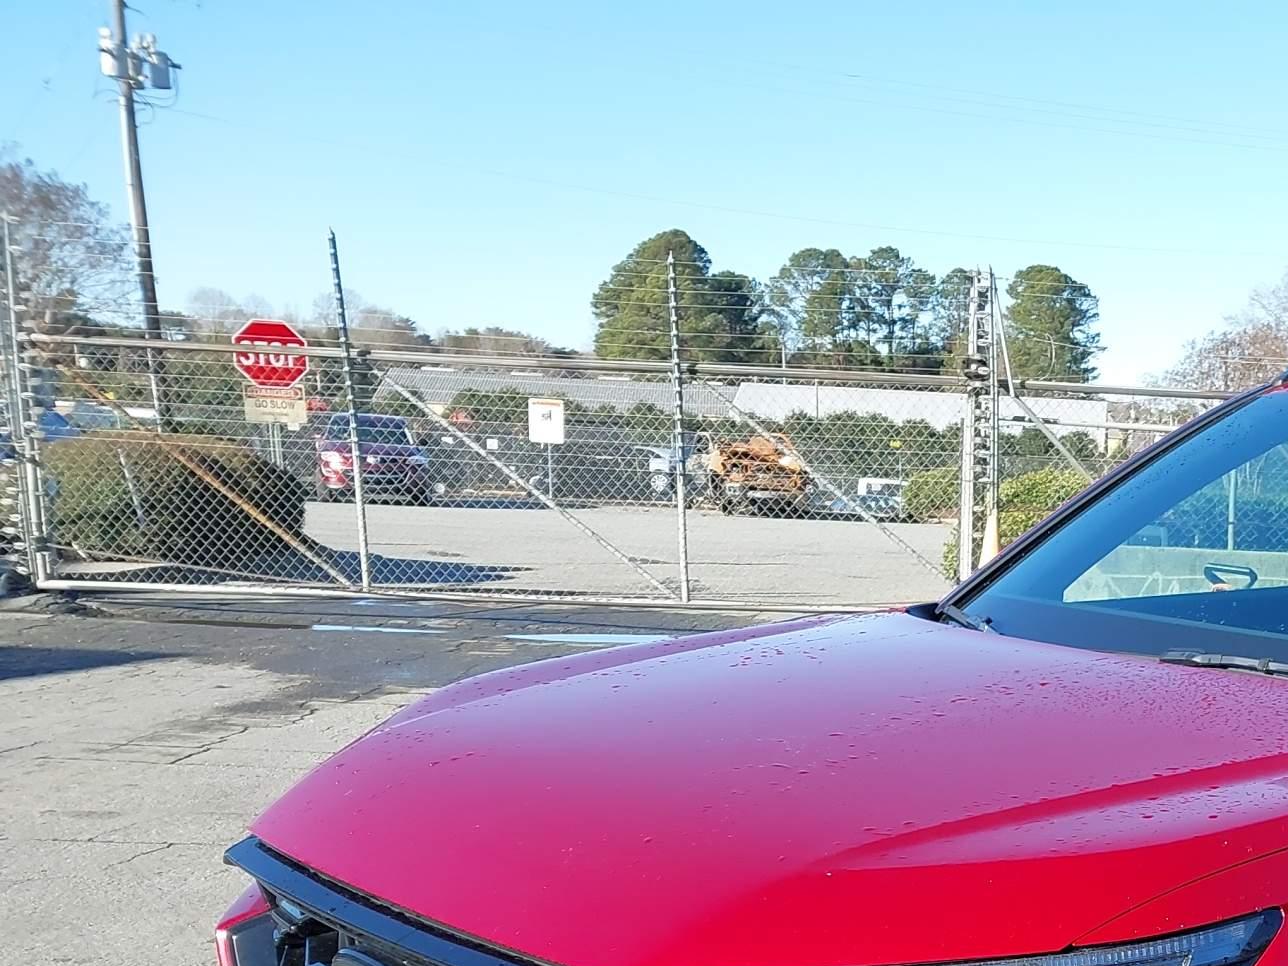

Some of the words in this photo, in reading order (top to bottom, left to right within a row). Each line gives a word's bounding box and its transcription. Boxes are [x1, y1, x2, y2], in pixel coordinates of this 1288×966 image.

[240, 341, 300, 367] STOP
[254, 400, 267, 409] GO
[270, 401, 295, 410] SLOW
